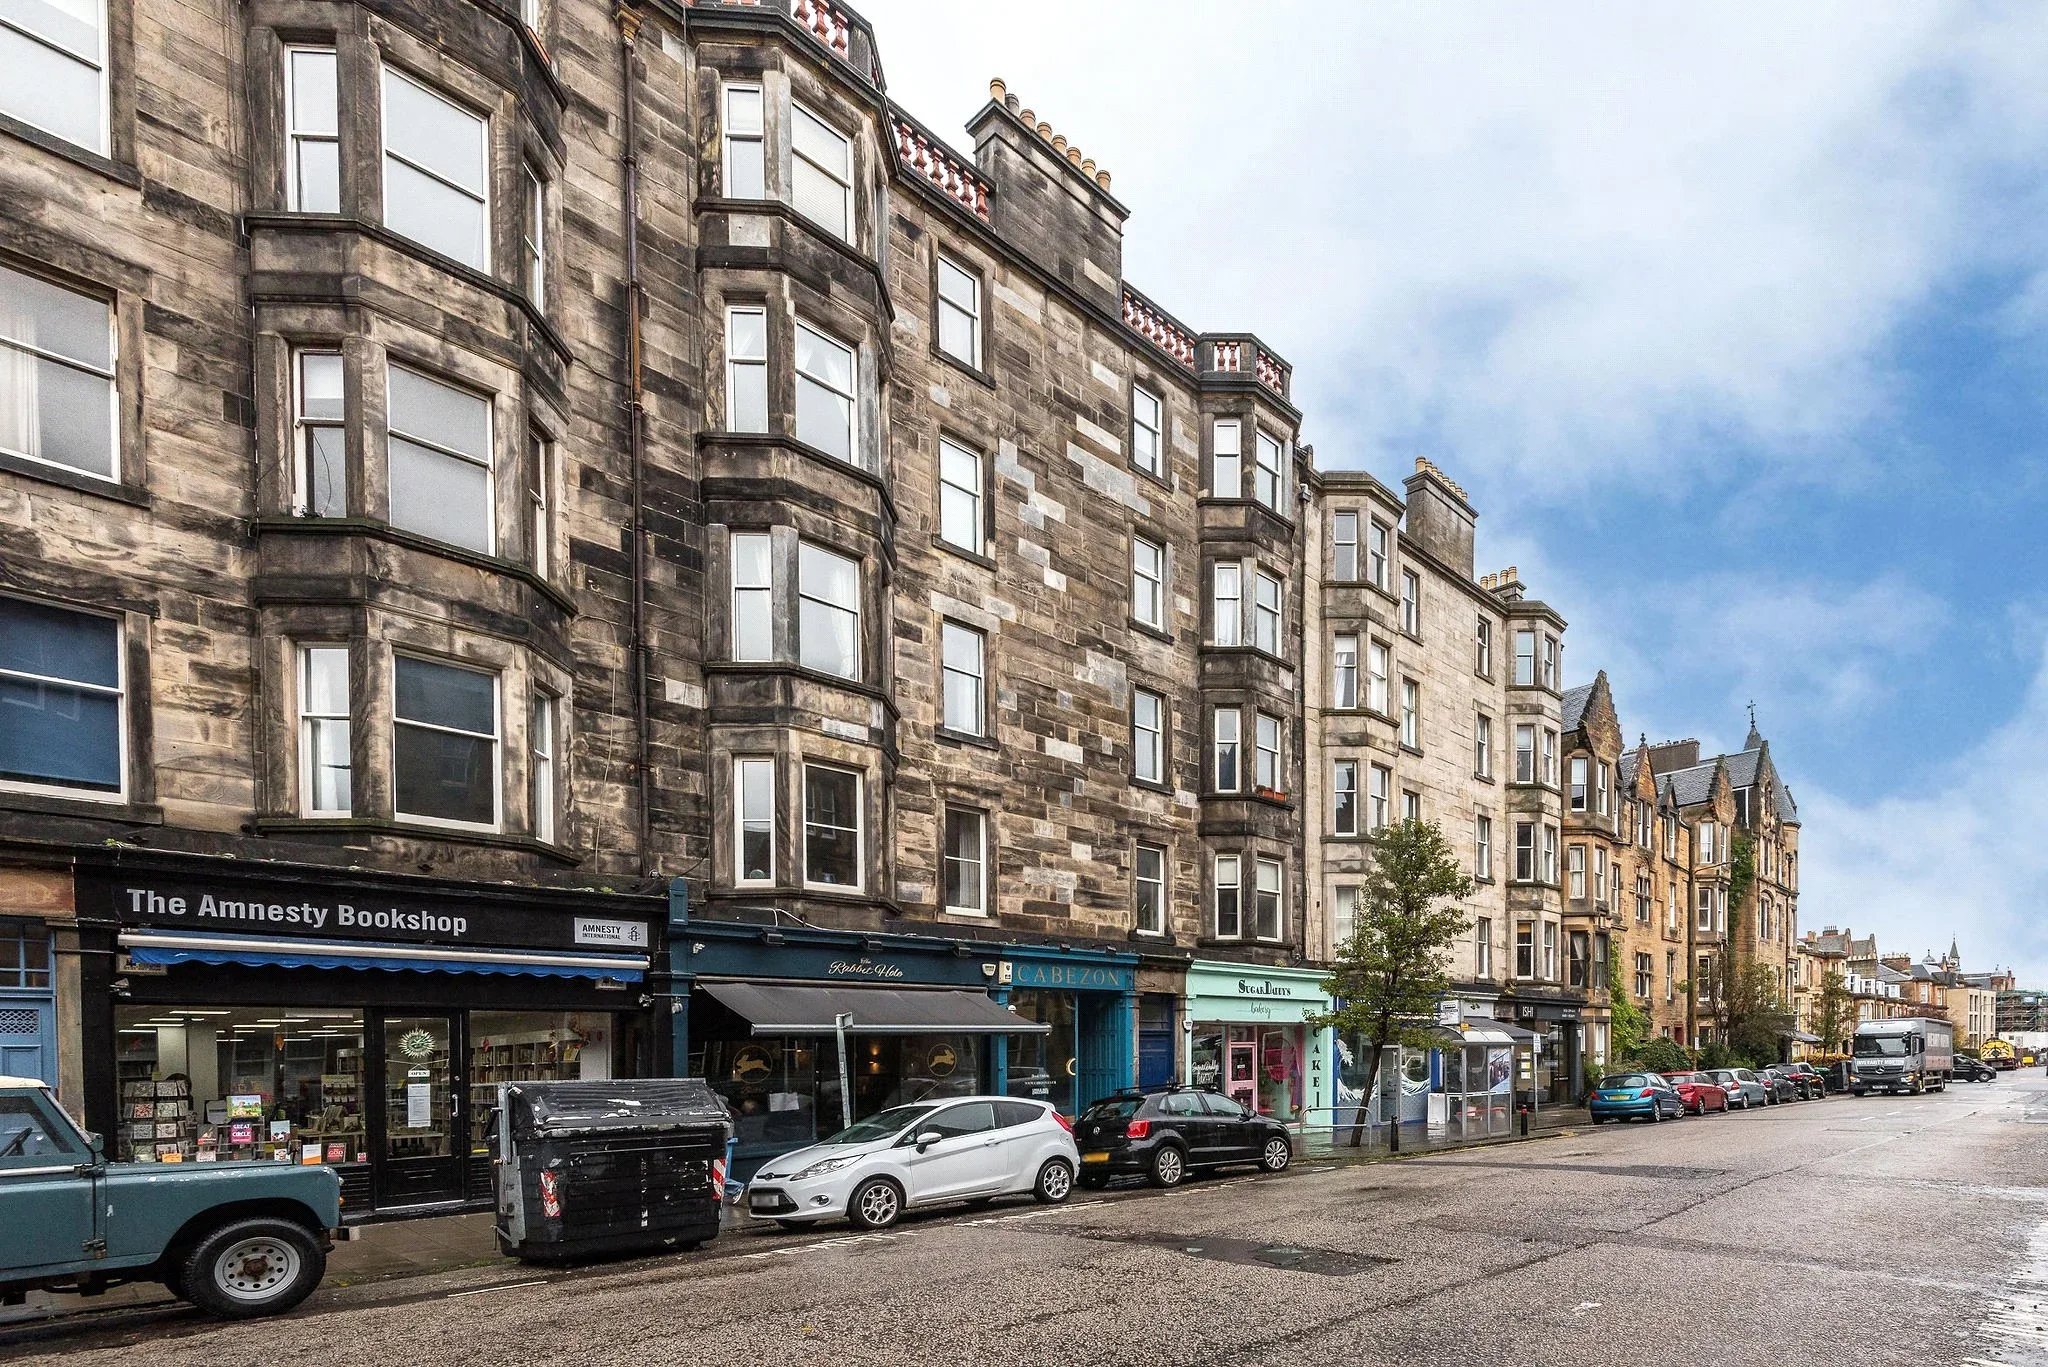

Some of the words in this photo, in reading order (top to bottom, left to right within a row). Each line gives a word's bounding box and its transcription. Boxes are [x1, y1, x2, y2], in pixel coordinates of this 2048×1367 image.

[126, 888, 187, 915] The
[198, 894, 329, 928] Amnesty
[338, 904, 467, 936] Bookshop
[582, 924, 621, 934] AMNESTY
[582, 932, 621, 940] INTERNATIONAL
[828, 960, 875, 975] Rabbit
[874, 963, 904, 978] Hole
[1017, 965, 1120, 987] CABEZON
